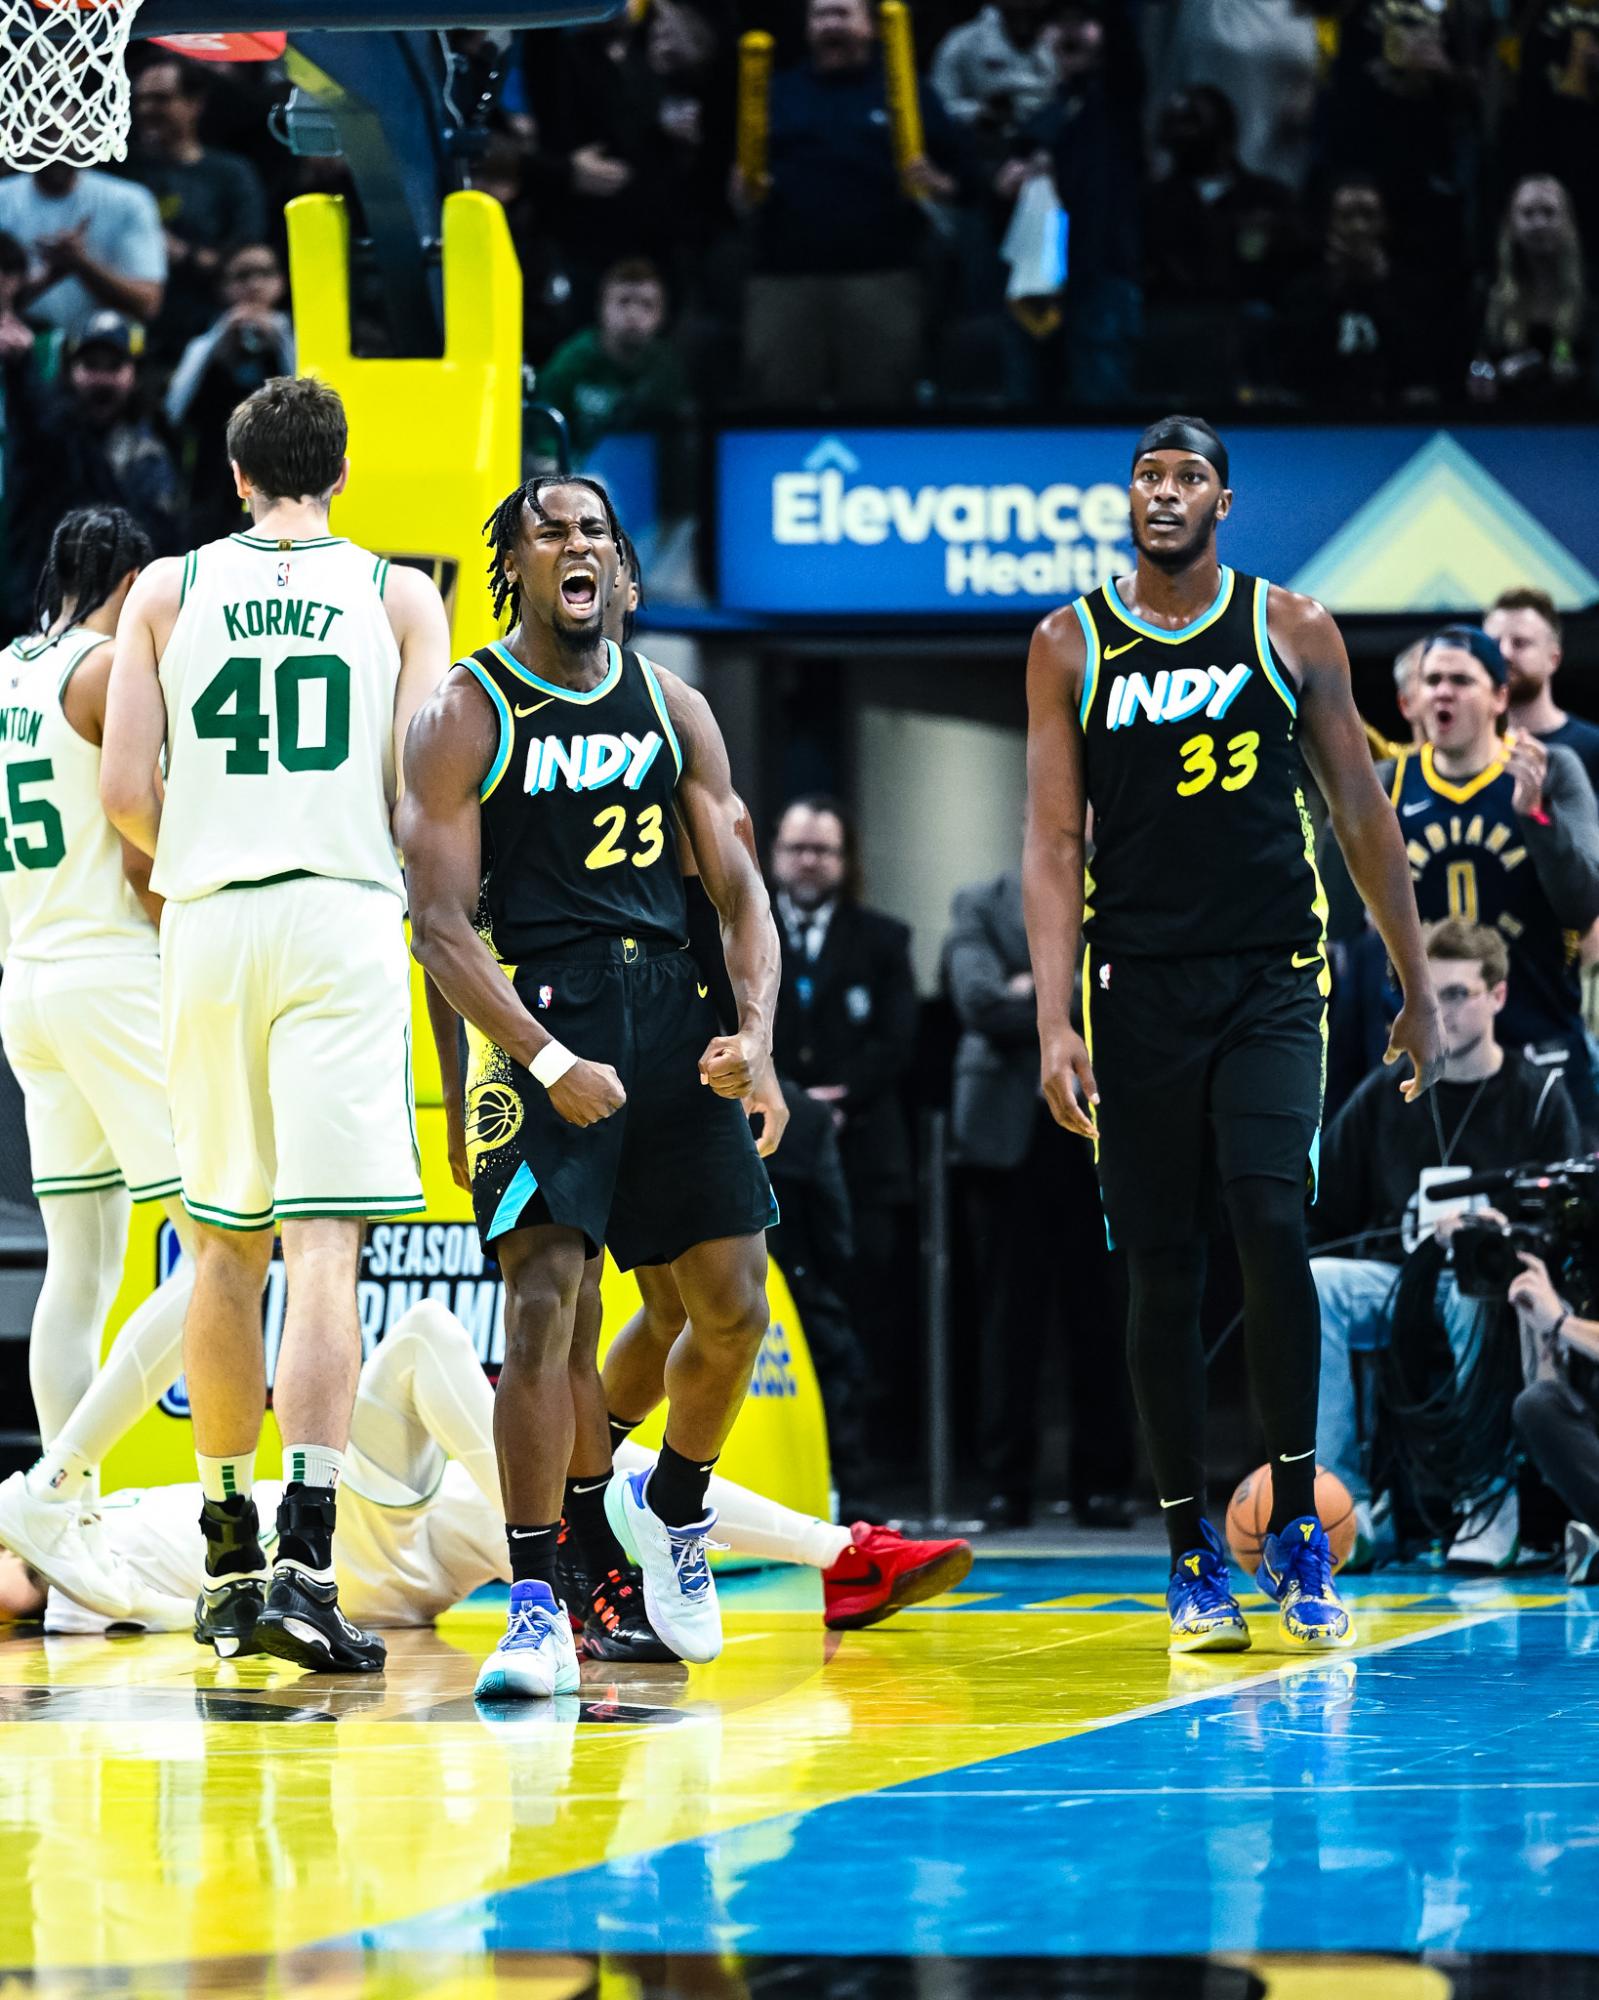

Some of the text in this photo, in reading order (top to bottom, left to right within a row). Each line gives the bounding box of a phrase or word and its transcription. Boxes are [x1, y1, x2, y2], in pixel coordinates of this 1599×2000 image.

[772, 469, 1130, 544] Elevance
[945, 542, 1132, 595] Health
[223, 598, 343, 641] KORNET
[191, 654, 351, 775] 40
[1106, 663, 1253, 732] INDY
[523, 731, 664, 796] INDY
[1176, 730, 1260, 797] 33
[0, 758, 66, 872] 5
[584, 804, 665, 870] 23
[1446, 860, 1479, 924] 0
